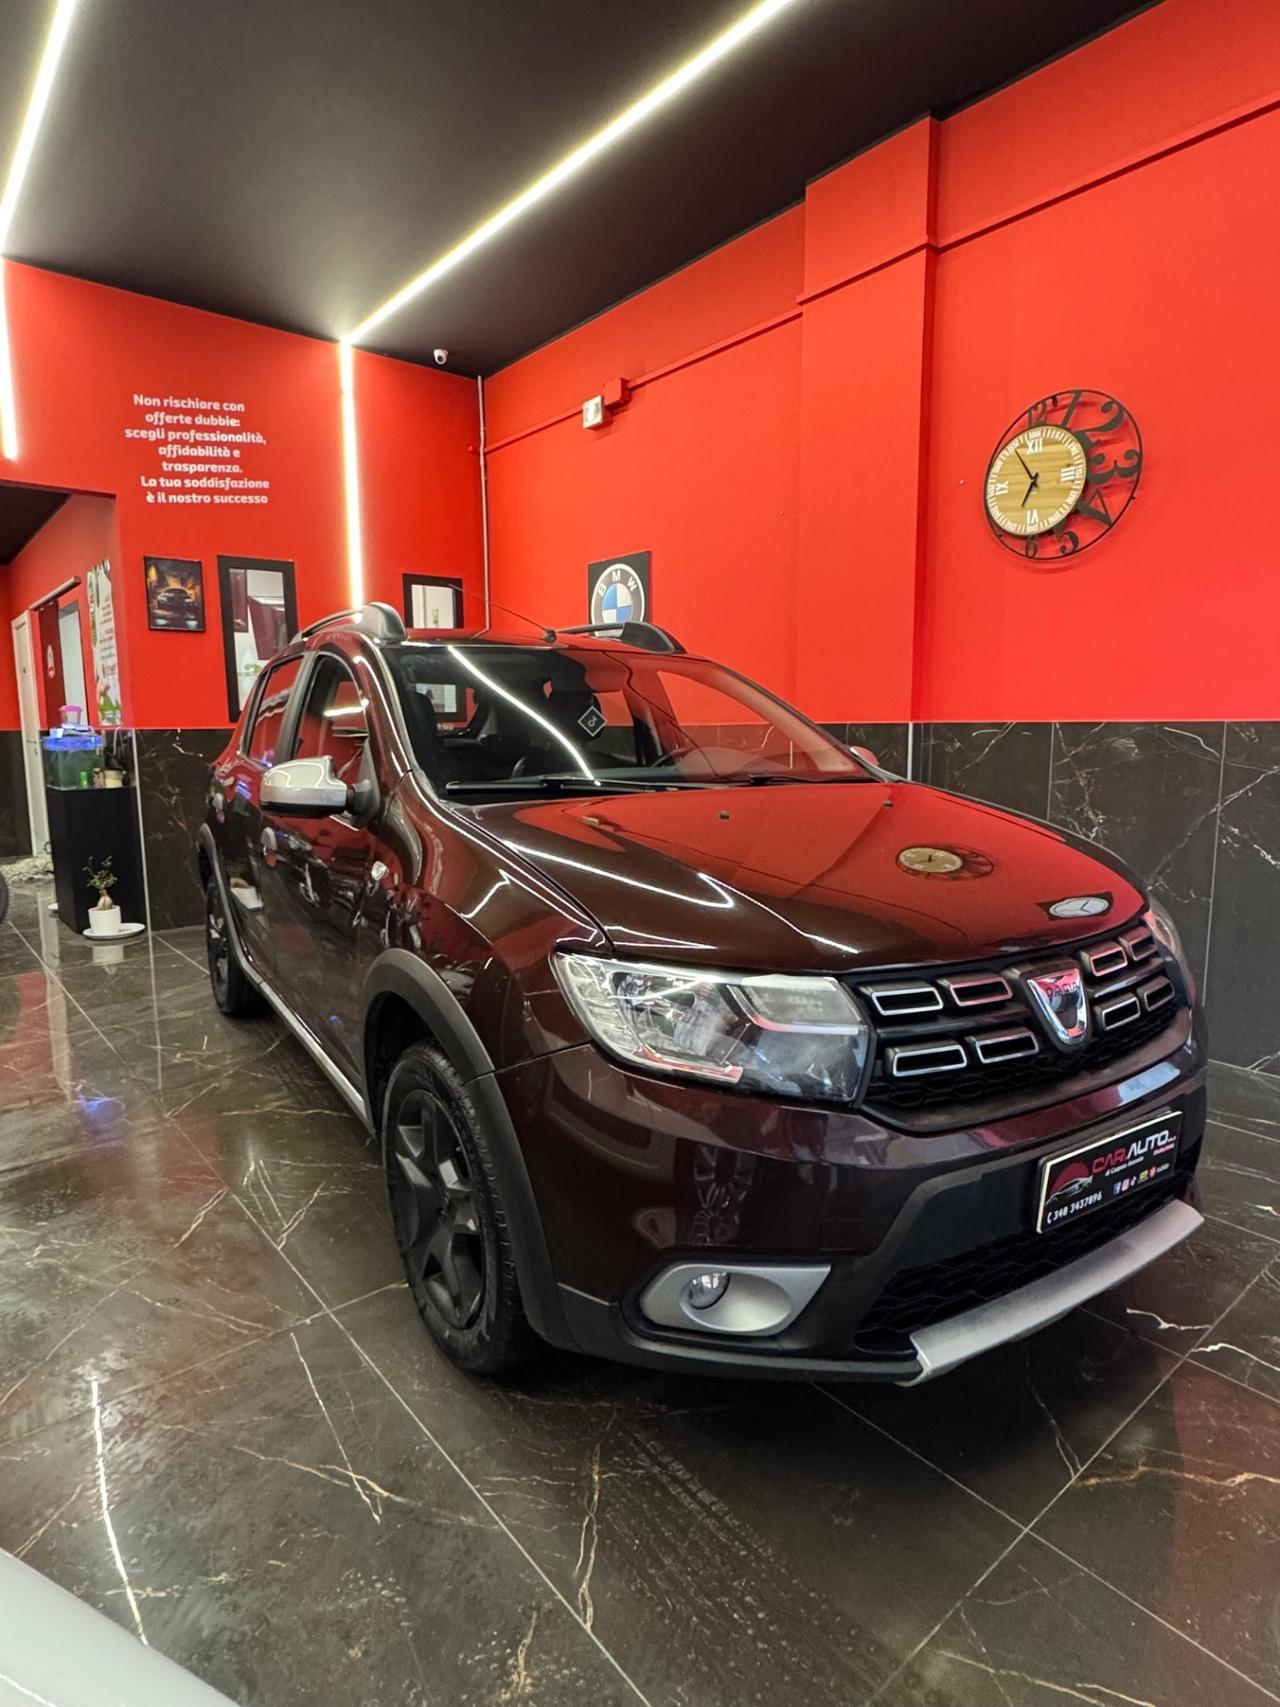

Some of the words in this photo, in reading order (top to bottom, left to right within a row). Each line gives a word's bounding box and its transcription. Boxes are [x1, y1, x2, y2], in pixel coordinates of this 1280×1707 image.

[133, 394, 161, 407] Non
[163, 396, 221, 411] rischiare
[223, 402, 245, 412] con
[145, 411, 192, 425] offerte
[195, 414, 240, 427] dubbie:
[125, 428, 165, 441] scegli
[168, 430, 267, 445] professionalità,
[158, 444, 231, 458] affidabilità
[232, 449, 240, 458] e
[1026, 437, 1043, 455] XII
[162, 461, 243, 474] trasparenza.
[141, 476, 156, 487] La
[160, 477, 182, 488] tua
[184, 477, 270, 490] soddisfazione
[146, 491, 155, 503] è
[157, 492, 166, 503] il
[168, 493, 211, 504] nostro
[213, 495, 269, 504] successo
[598, 569, 638, 597] BMW
